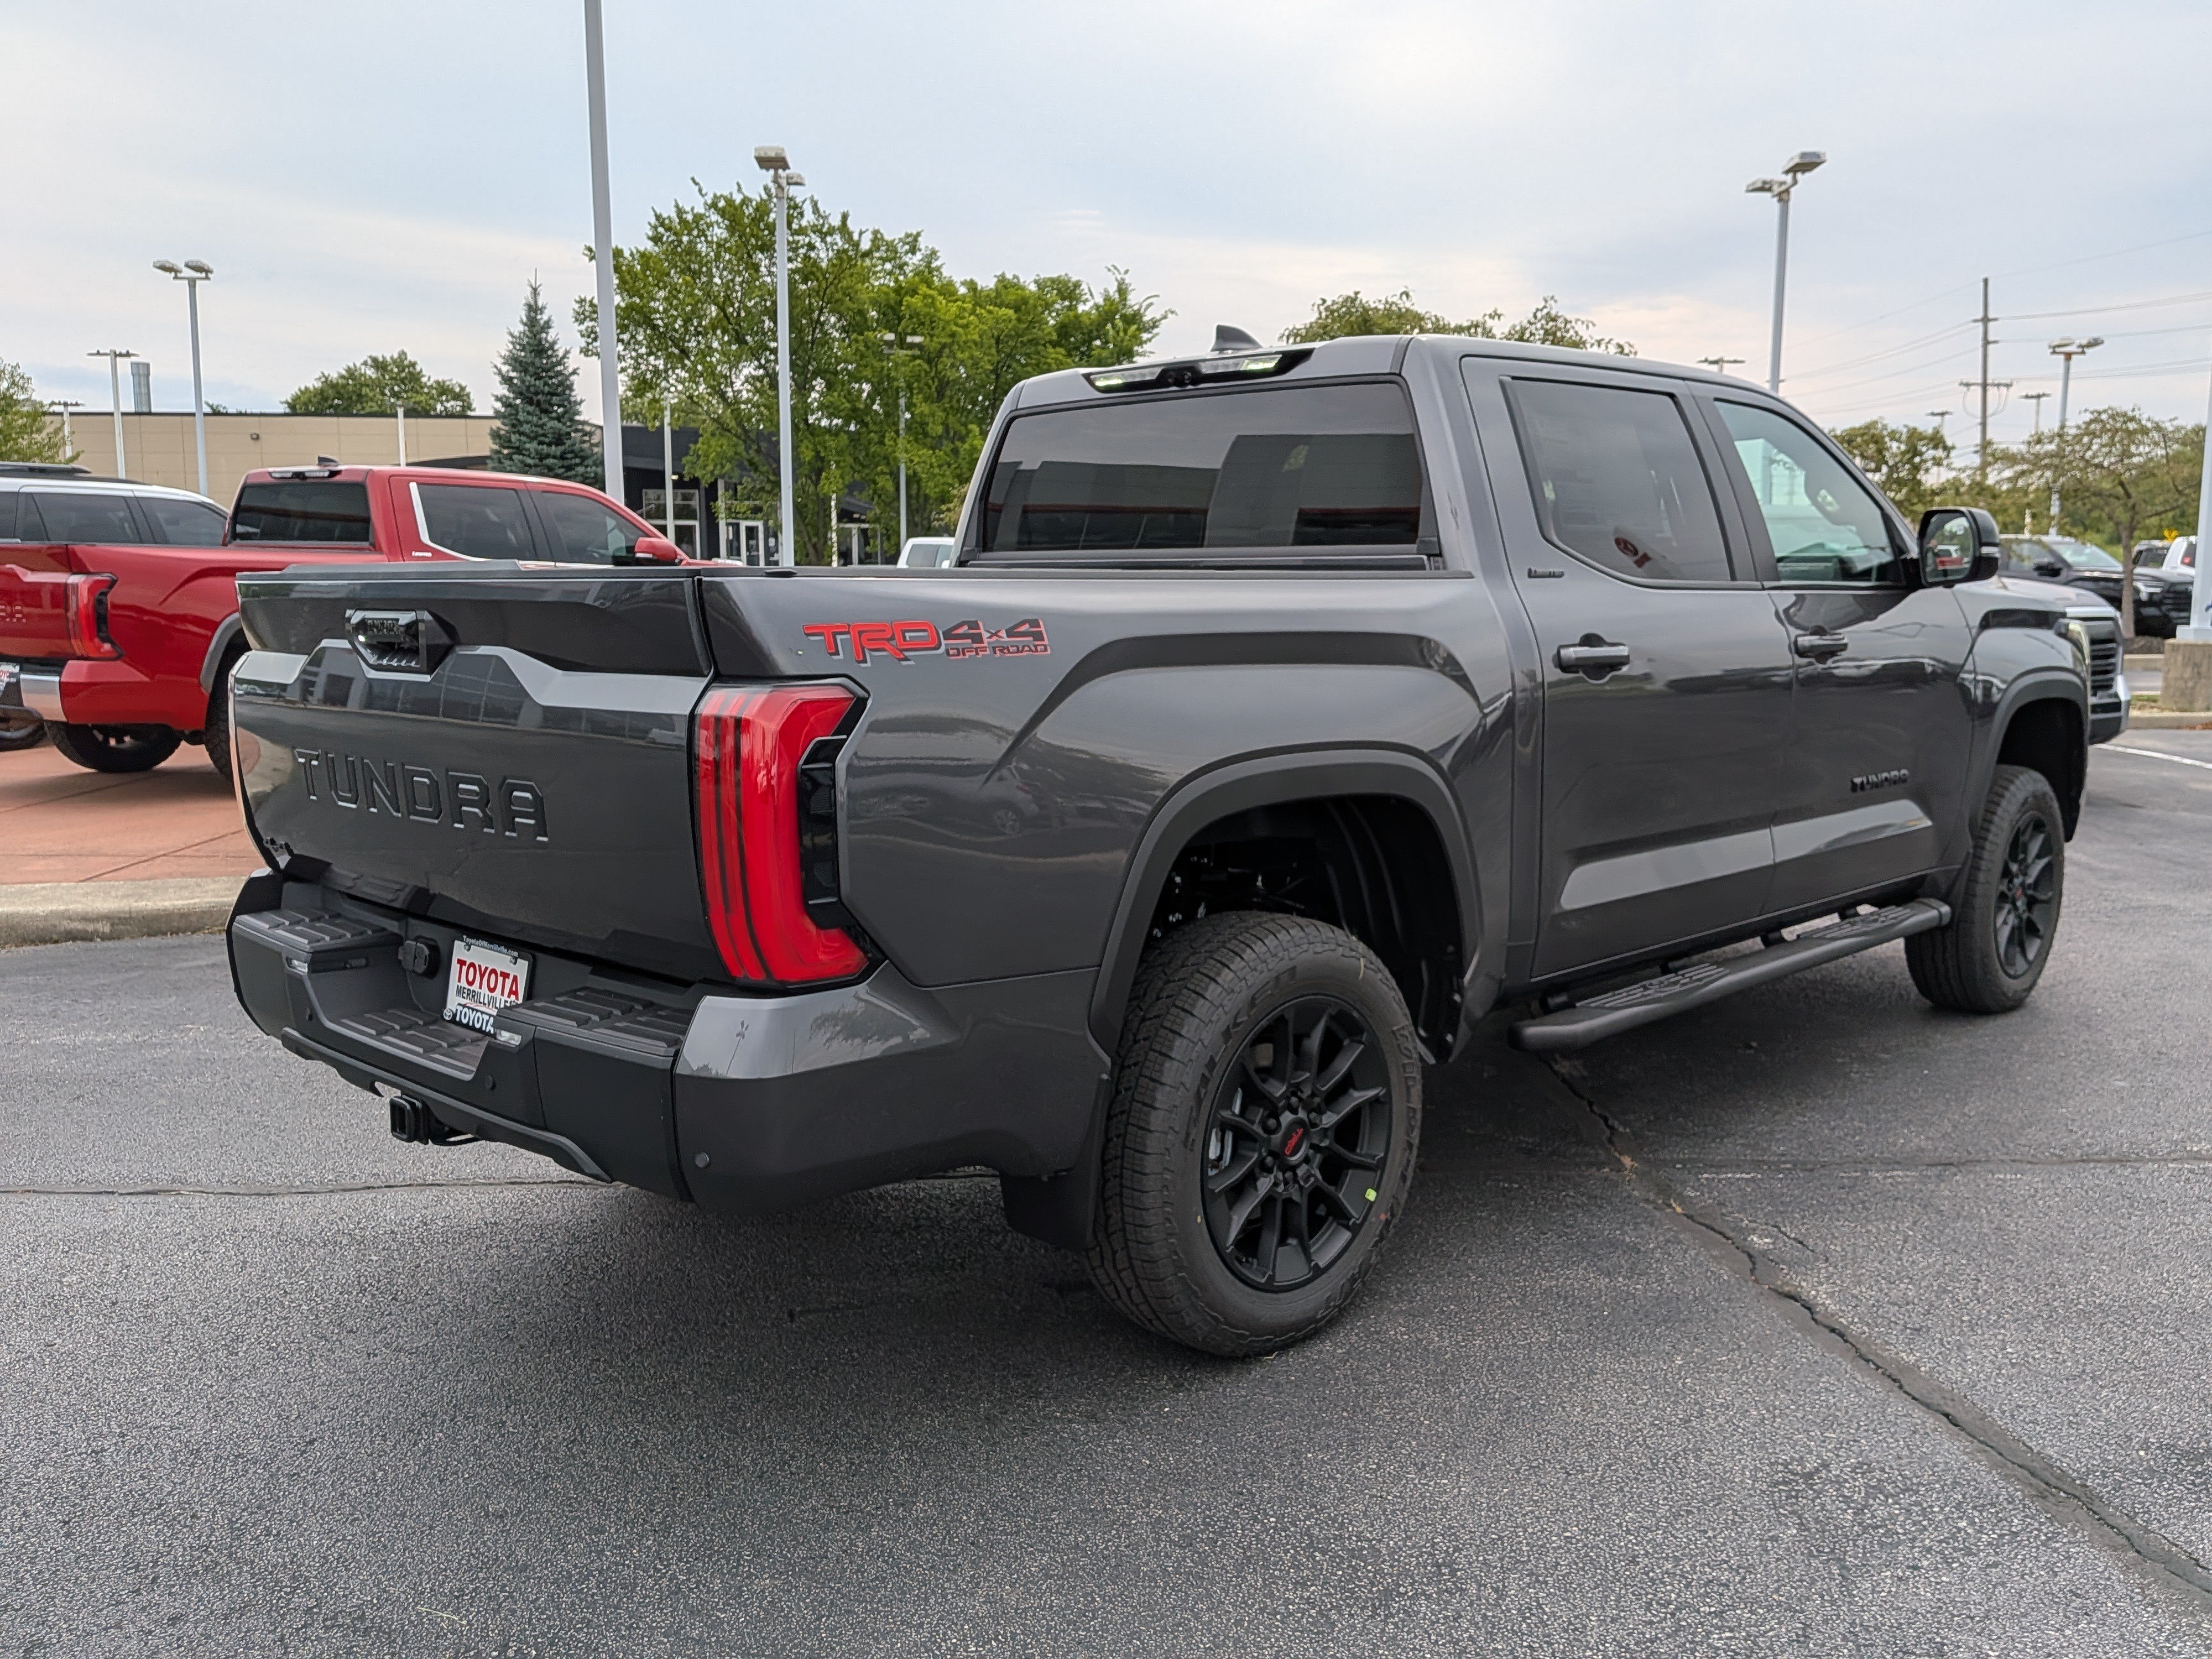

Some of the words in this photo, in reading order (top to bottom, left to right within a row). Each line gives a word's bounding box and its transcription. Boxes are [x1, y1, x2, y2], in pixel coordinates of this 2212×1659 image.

[803, 620, 942, 666] TRD
[946, 646, 990, 659] OFF
[992, 644, 1051, 657] ROAD
[294, 747, 549, 842] TUNDRA
[457, 958, 519, 1001] TOYOTA
[455, 1005, 494, 1035] TOYOTA
